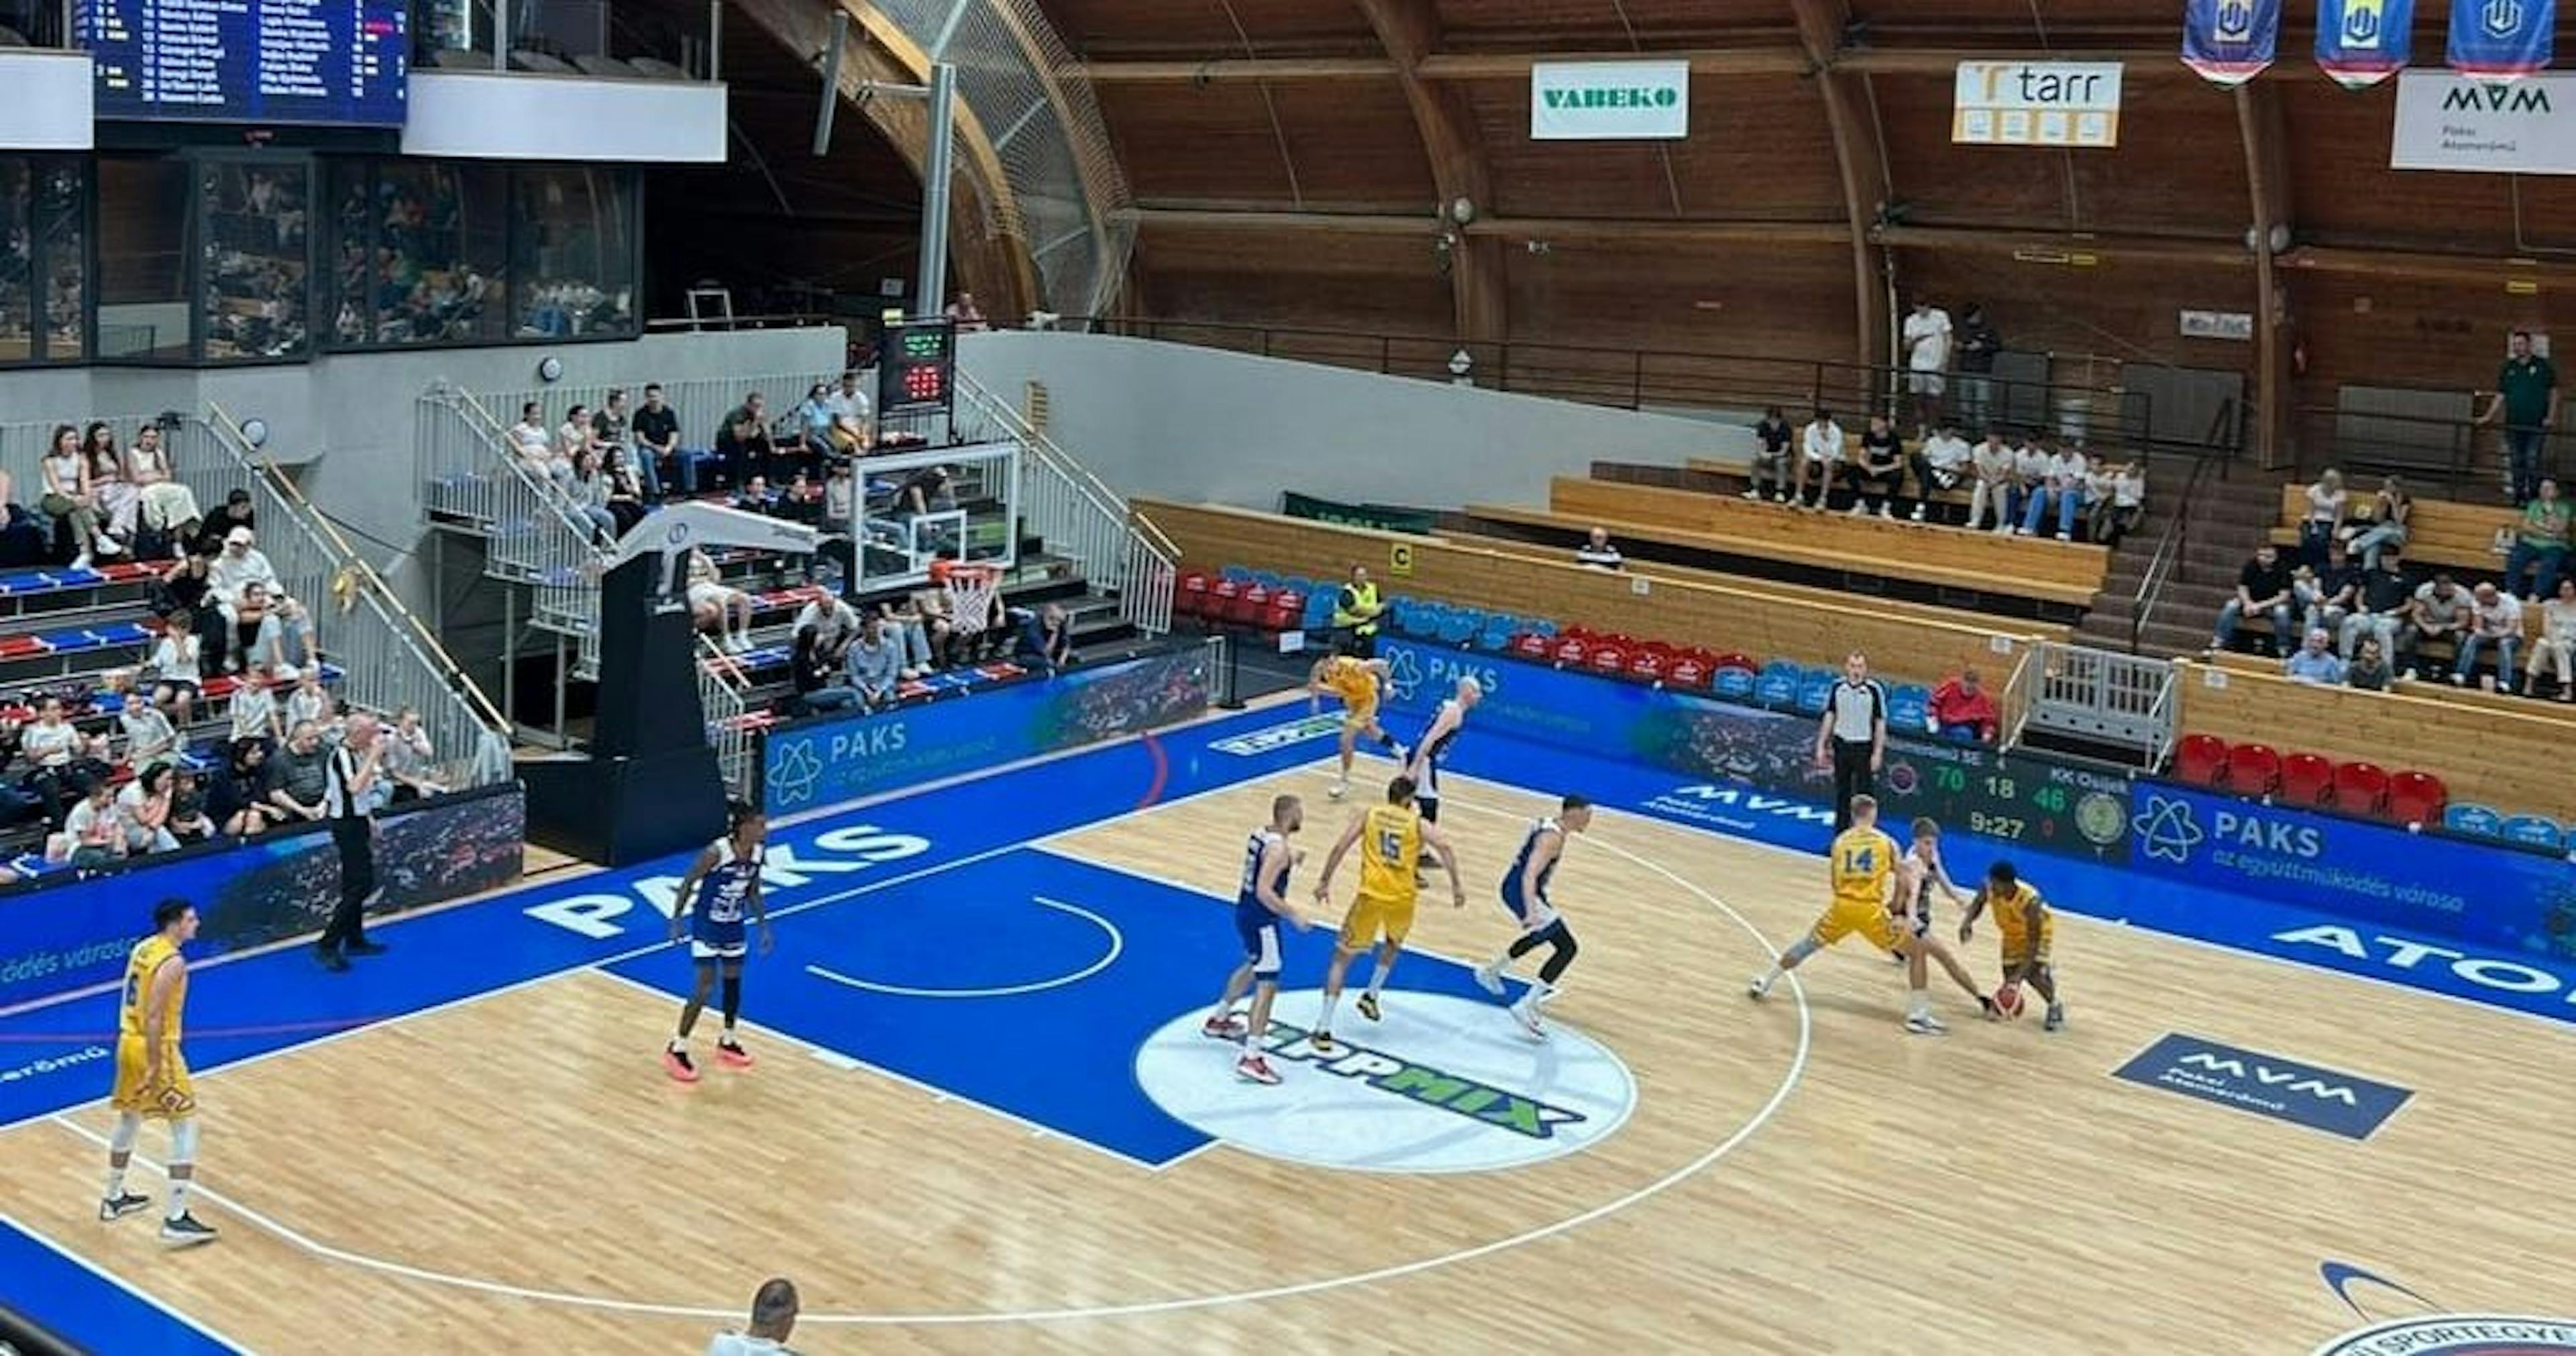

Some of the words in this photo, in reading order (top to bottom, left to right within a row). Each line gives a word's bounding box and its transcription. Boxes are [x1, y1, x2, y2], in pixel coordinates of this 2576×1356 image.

[1544, 87, 1678, 109] VABEKO
[2018, 66, 2102, 103] tarr
[1394, 547, 1409, 566] C
[830, 723, 906, 763] PAKS
[1932, 765, 1965, 792] 70
[1985, 776, 2015, 800] 18
[2033, 786, 2065, 813] 46
[1970, 811, 2025, 839] 9:27
[2214, 811, 2320, 857] PAKS
[1379, 830, 1400, 859] 15
[1845, 847, 1872, 873] 14
[523, 825, 931, 939] PAKS
[2269, 925, 2576, 1003] ATO
[2178, 1052, 2357, 1106] MVM
